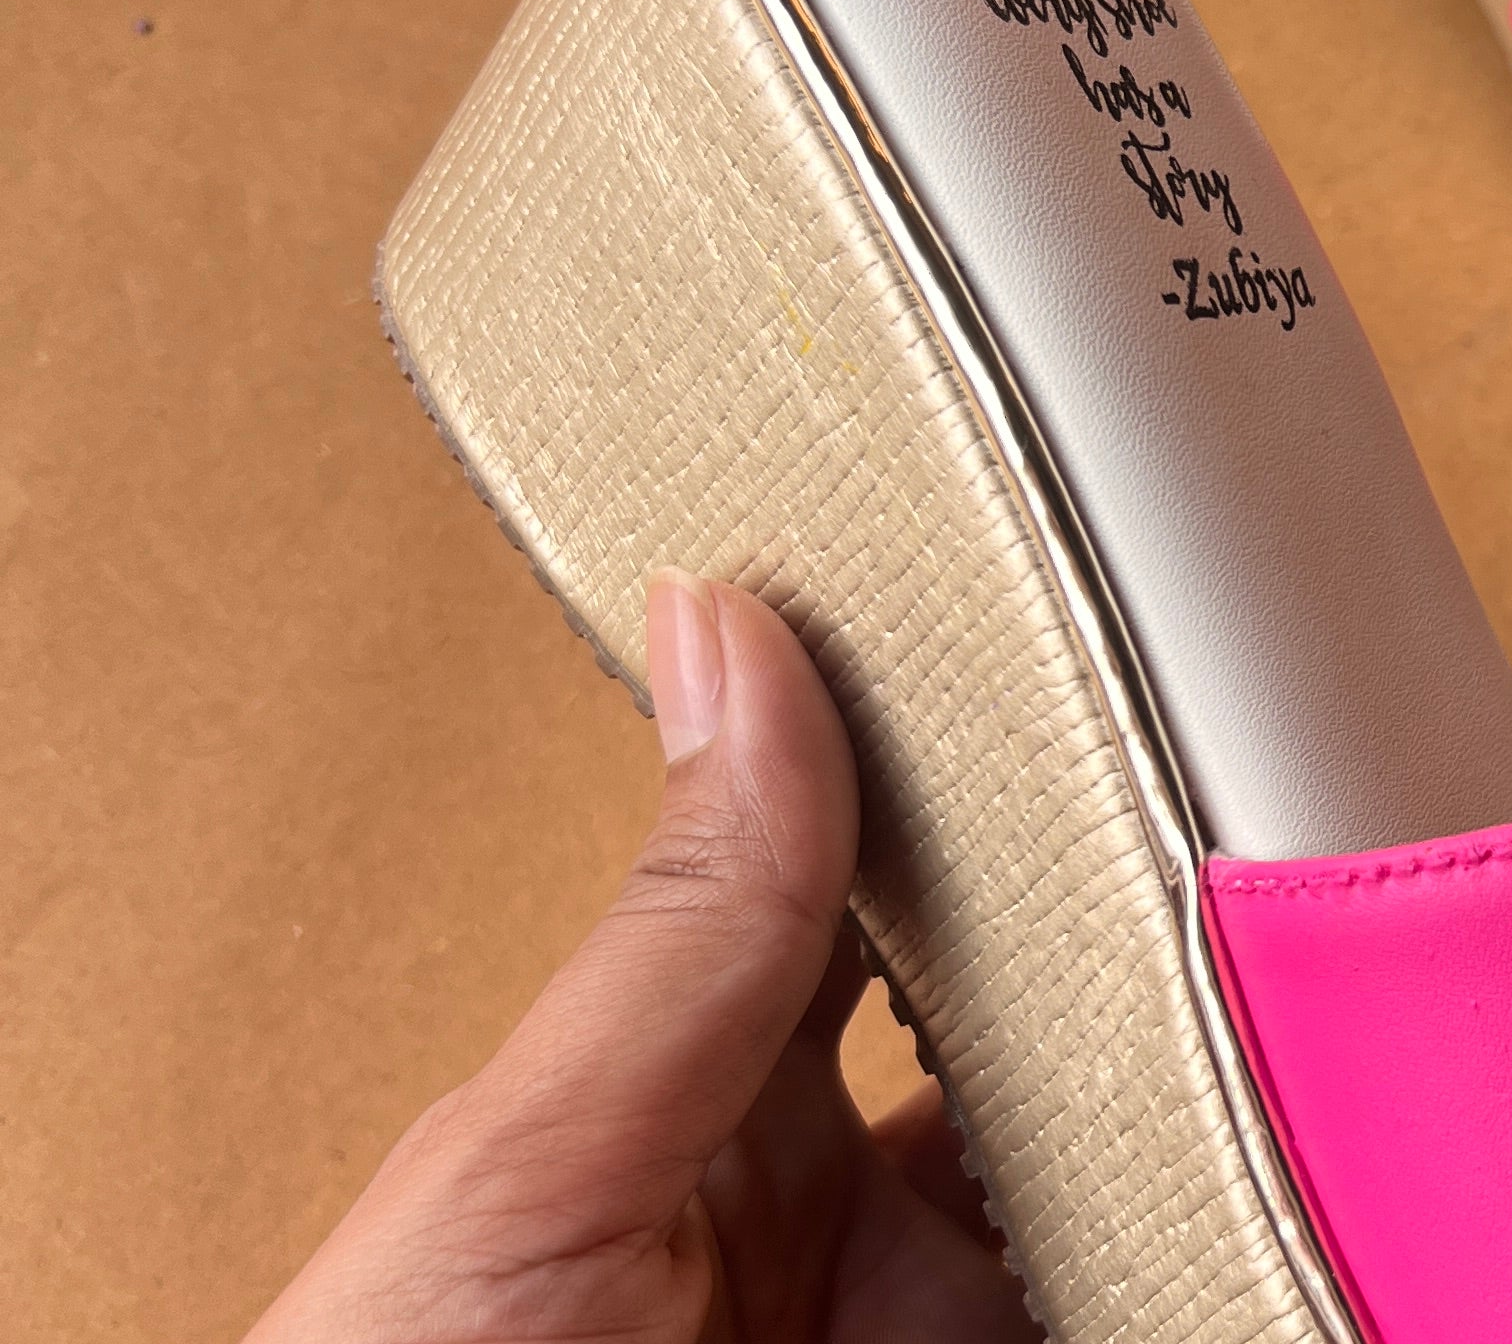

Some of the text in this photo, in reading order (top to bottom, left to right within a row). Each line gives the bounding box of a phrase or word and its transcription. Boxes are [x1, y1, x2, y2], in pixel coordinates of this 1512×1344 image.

[1062, 44, 1191, 126] has a
[1120, 131, 1243, 234] story
[1161, 246, 1315, 331] -Zubiya
